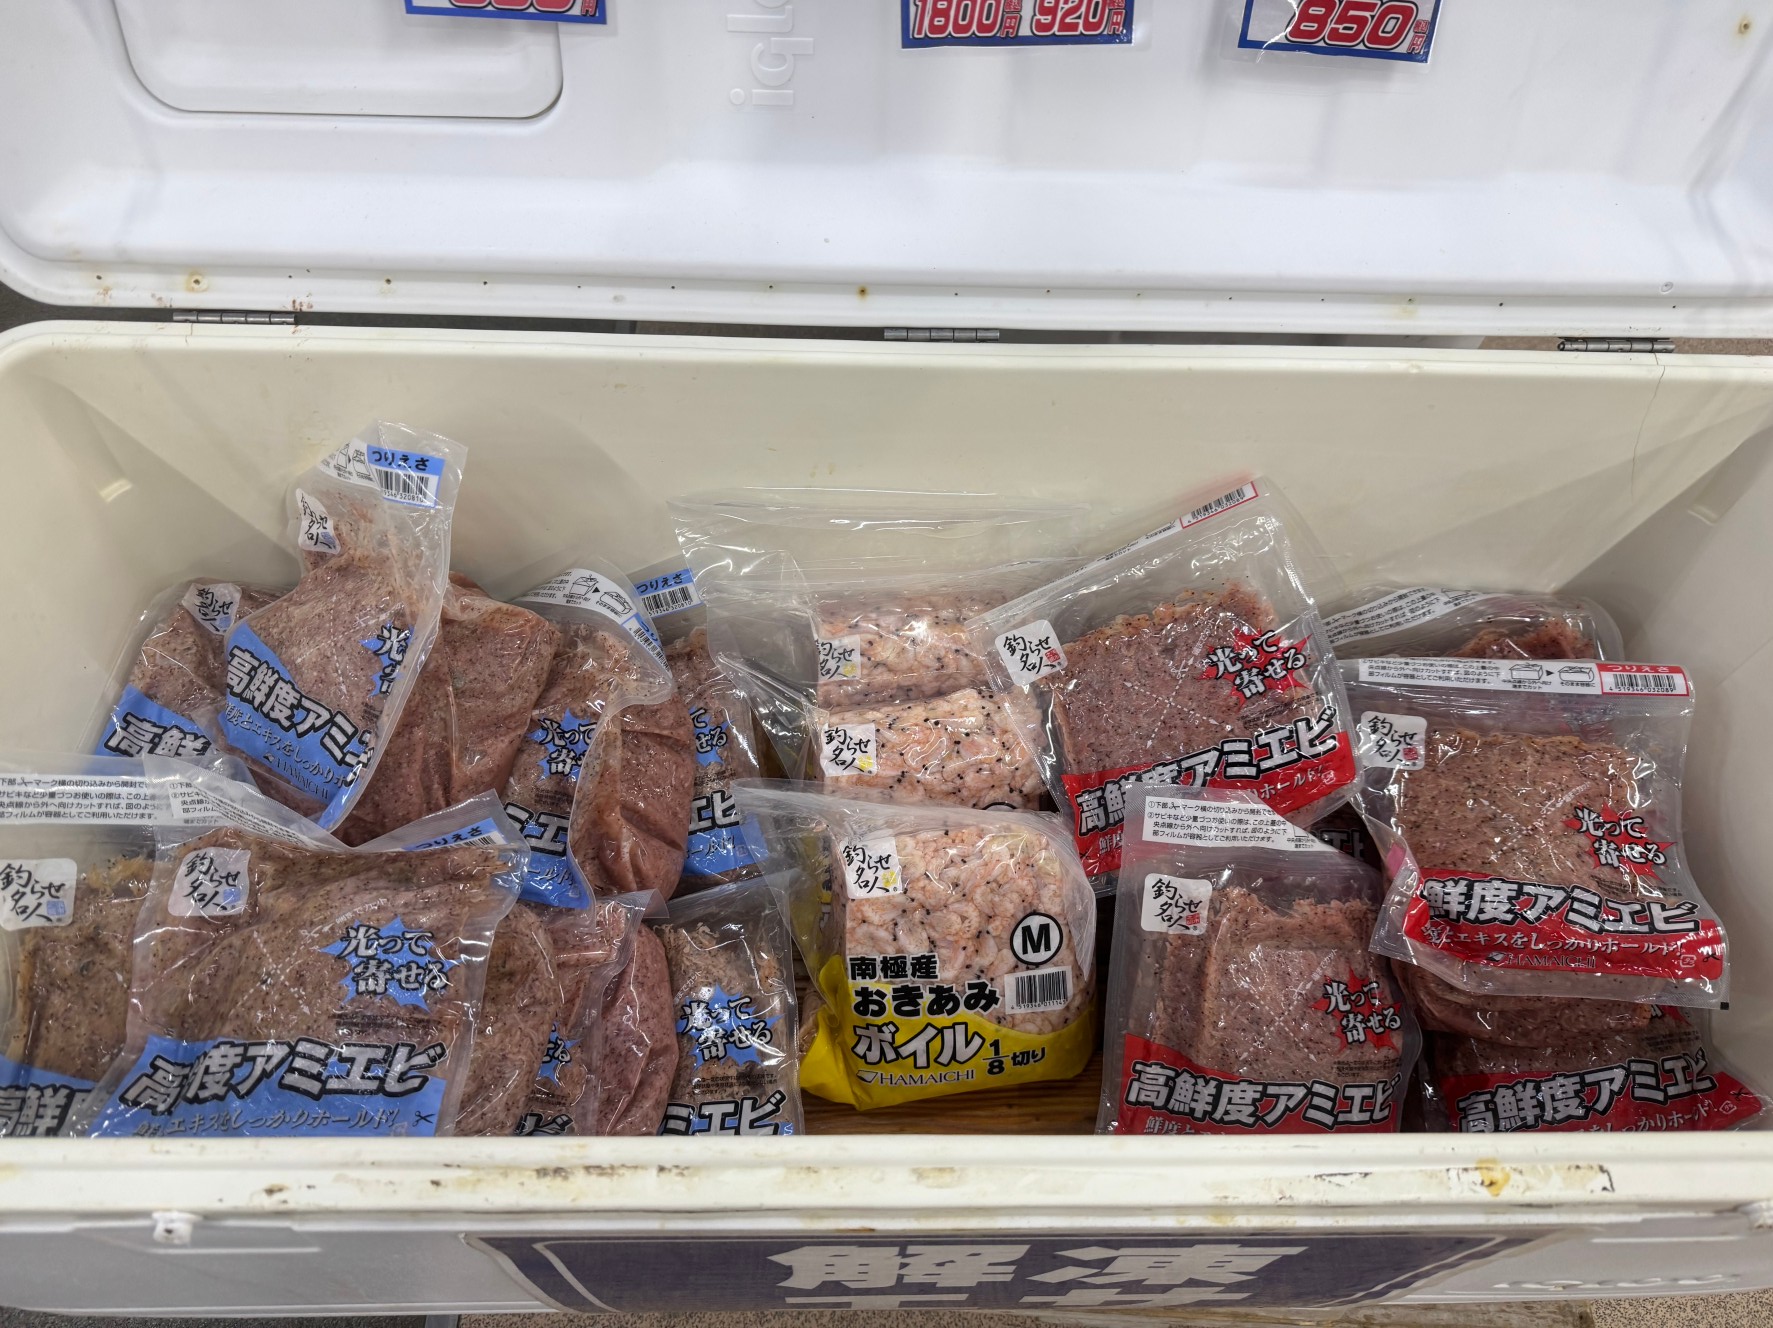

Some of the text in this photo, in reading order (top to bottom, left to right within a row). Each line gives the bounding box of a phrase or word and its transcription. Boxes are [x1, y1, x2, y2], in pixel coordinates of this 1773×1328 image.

[913, 0, 1000, 37] 1800
[1031, 0, 1109, 35] 920
[1285, 0, 1418, 50] 850
[727, 0, 814, 106] igl
[372, 451, 430, 472] つりえさ
[637, 573, 684, 594] つりえさ
[1004, 634, 1052, 657] 釣らせ
[1206, 630, 1280, 680] 光って
[1235, 648, 1307, 699] 寄せる
[1607, 664, 1670, 673] つりえさ
[825, 728, 871, 755] 釣らせ
[1368, 715, 1418, 747] 釣らせ
[547, 749, 582, 776] 寄
[828, 747, 865, 772] 名人
[416, 826, 483, 849] つりえさ
[1574, 807, 1644, 838] 光って
[842, 845, 891, 875] 釣らせ
[1592, 838, 1667, 868] 寄せる
[0, 862, 65, 900] 釣らせ
[185, 852, 241, 888] 釣らせ
[854, 866, 890, 894] 名人
[10, 889, 54, 922] 名人
[189, 878, 229, 911] 名人
[1151, 878, 1203, 914] 釣らせ
[1420, 877, 1700, 935] 鮮度アミエビ
[1157, 899, 1193, 931] 名人
[337, 925, 433, 958] 光って
[1021, 924, 1051, 955] M
[352, 959, 448, 995] 寄せる
[849, 955, 939, 980] 南極産
[1506, 953, 1596, 968] HAMAICHI
[853, 982, 1000, 1017] おきあみ
[1323, 980, 1380, 1014] 光って
[680, 997, 752, 1035] 光って
[1341, 1007, 1401, 1044] 寄せる
[851, 1021, 986, 1069] ボイル
[1011, 1047, 1046, 1067] 切り
[879, 1069, 975, 1086] HAMAICHI
[1455, 1047, 1718, 1132] 高鮮度アミエビ
[661, 1089, 786, 1136] ミエビ
[1125, 1061, 1401, 1131] 高鮮度アミエビ
